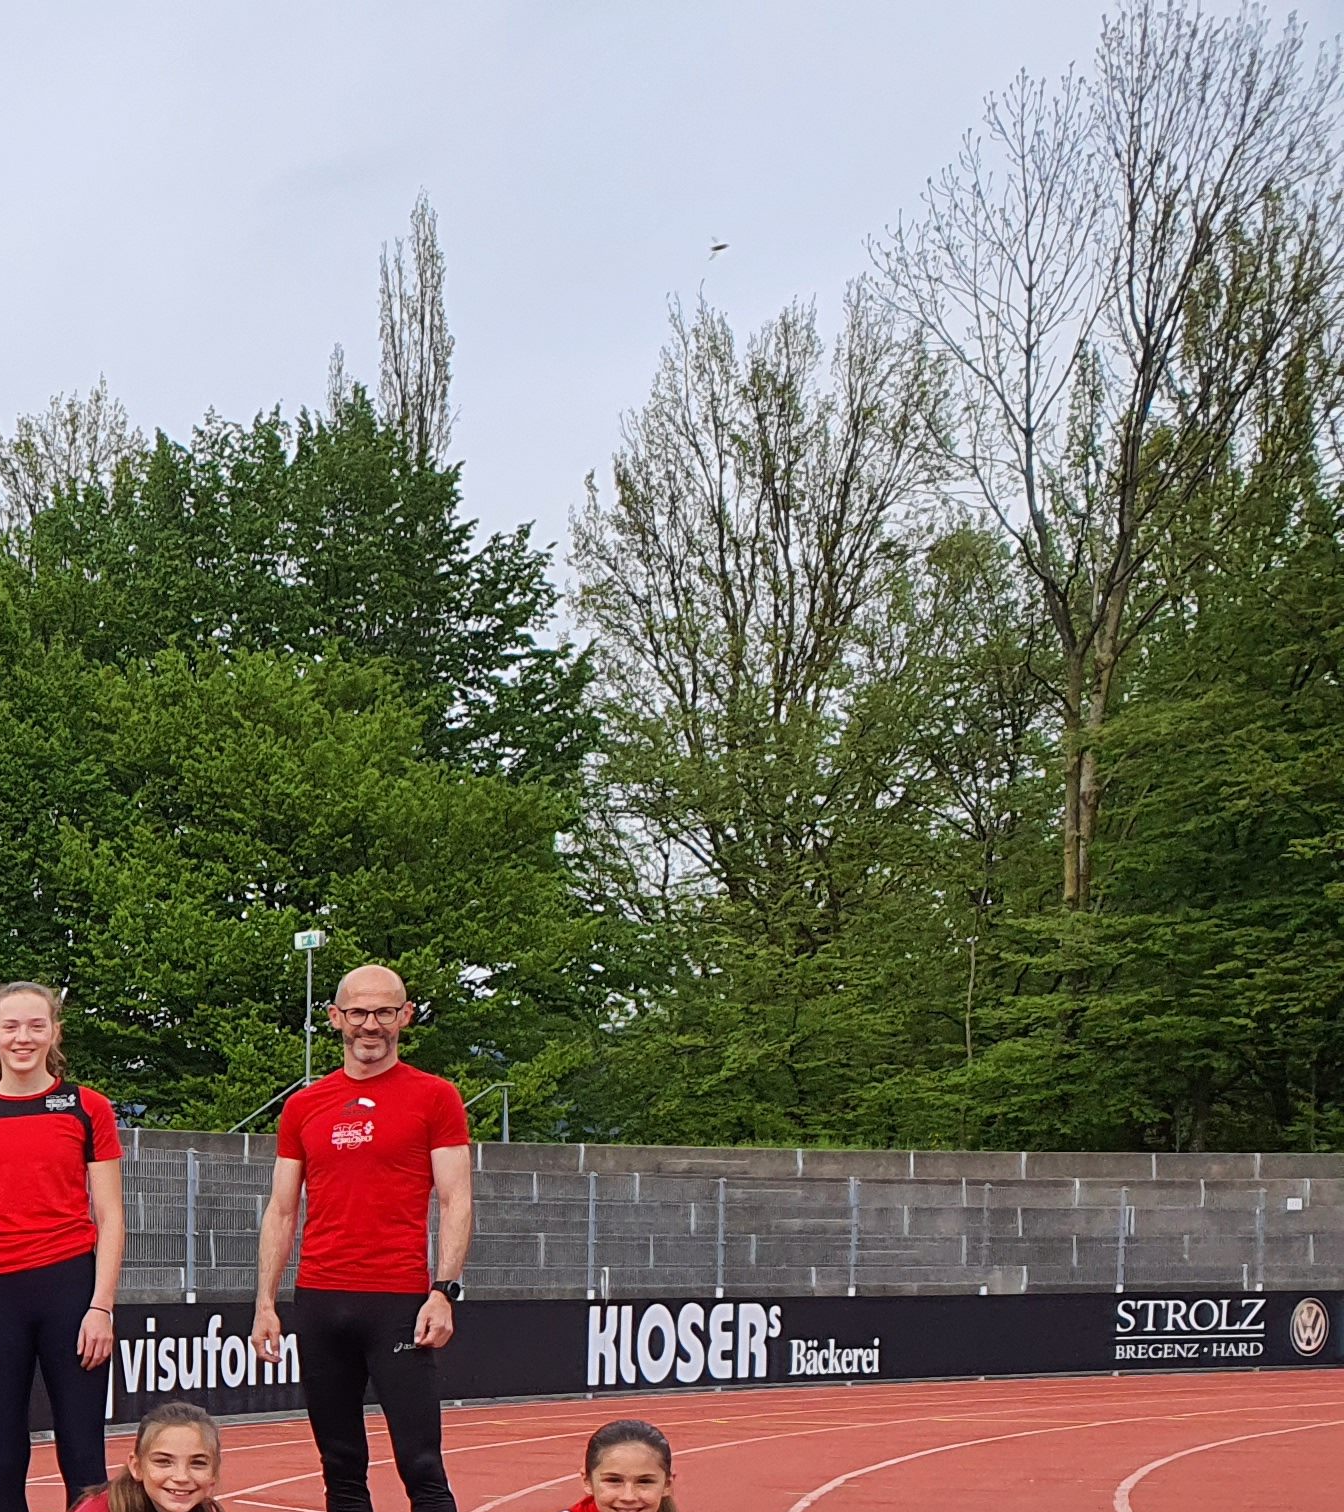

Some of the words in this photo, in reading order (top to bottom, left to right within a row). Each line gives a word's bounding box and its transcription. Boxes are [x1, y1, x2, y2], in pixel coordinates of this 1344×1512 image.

[1115, 1298, 1267, 1334] STROLZ
[119, 1314, 301, 1393] visuform
[787, 1337, 881, 1376] Bäckerei
[1115, 1342, 1200, 1360] BREGENZ
[1212, 1342, 1264, 1358] HARD
